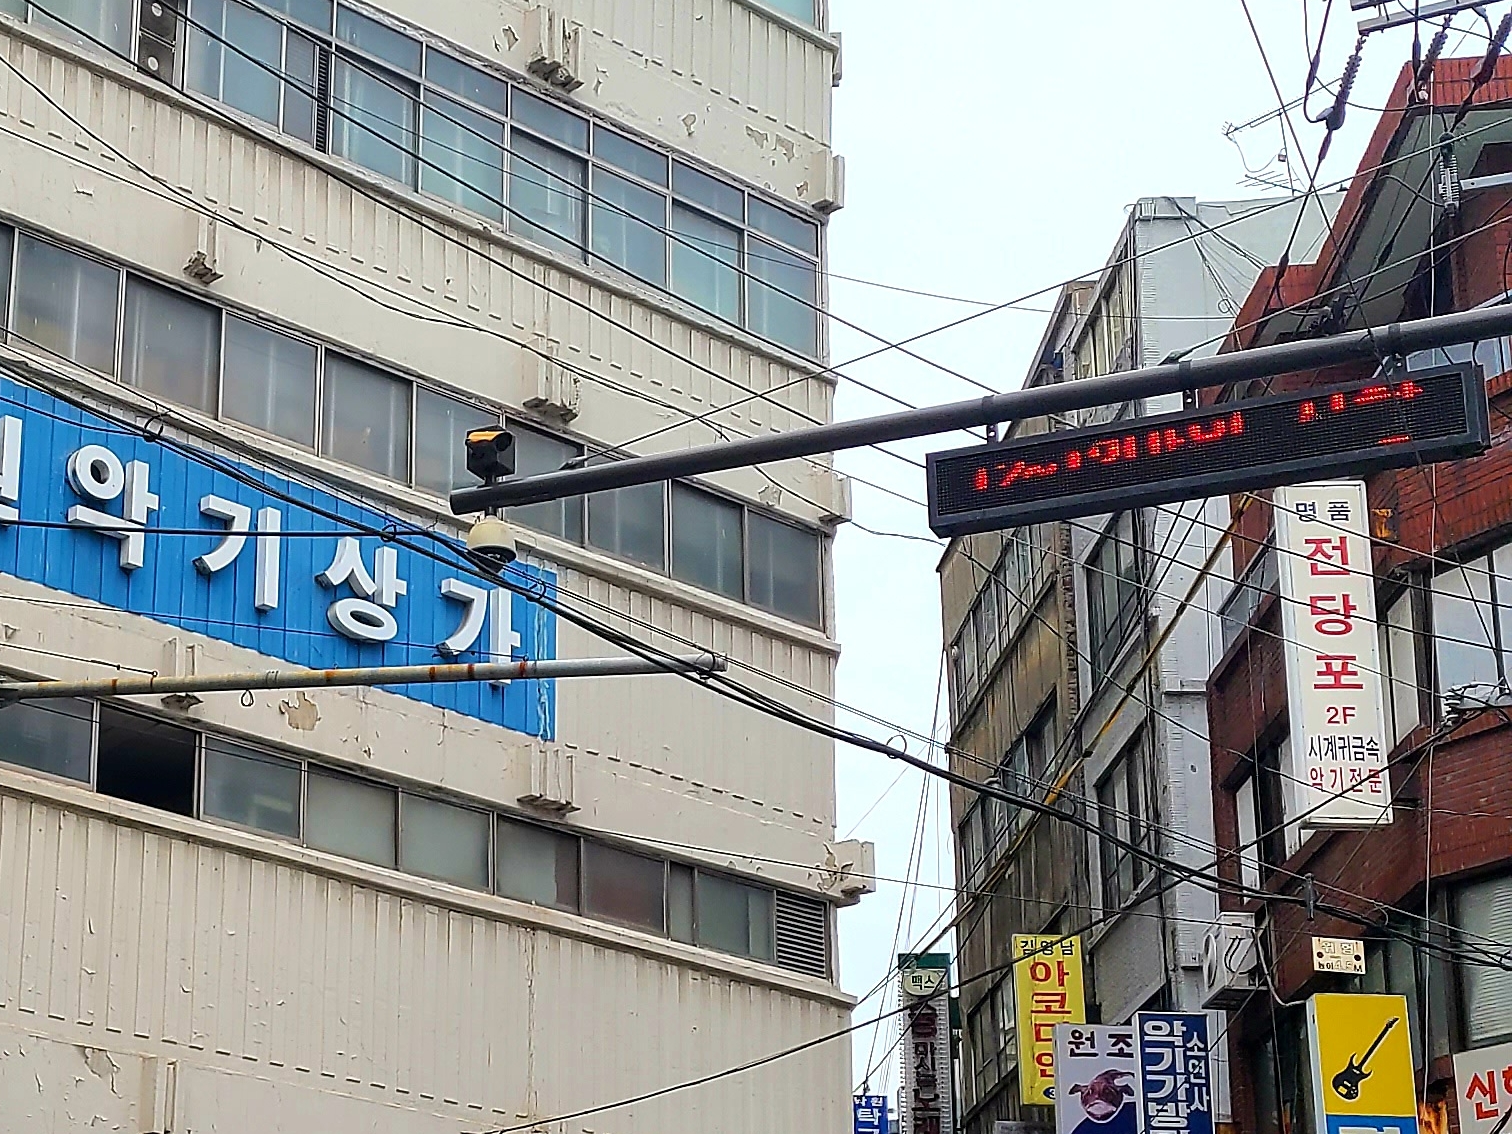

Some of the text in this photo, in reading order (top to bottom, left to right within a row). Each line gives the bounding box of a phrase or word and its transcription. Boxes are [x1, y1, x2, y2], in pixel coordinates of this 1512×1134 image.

[1295, 501, 1352, 522] 명품
[1304, 535, 1364, 690] 전당포
[1326, 706, 1356, 724] 2F
[1309, 735, 1380, 762] 시계귀금속
[1020, 940, 1074, 956] 김영남
[911, 975, 935, 991] 맥스
[1068, 1029, 1135, 1059] 원조
